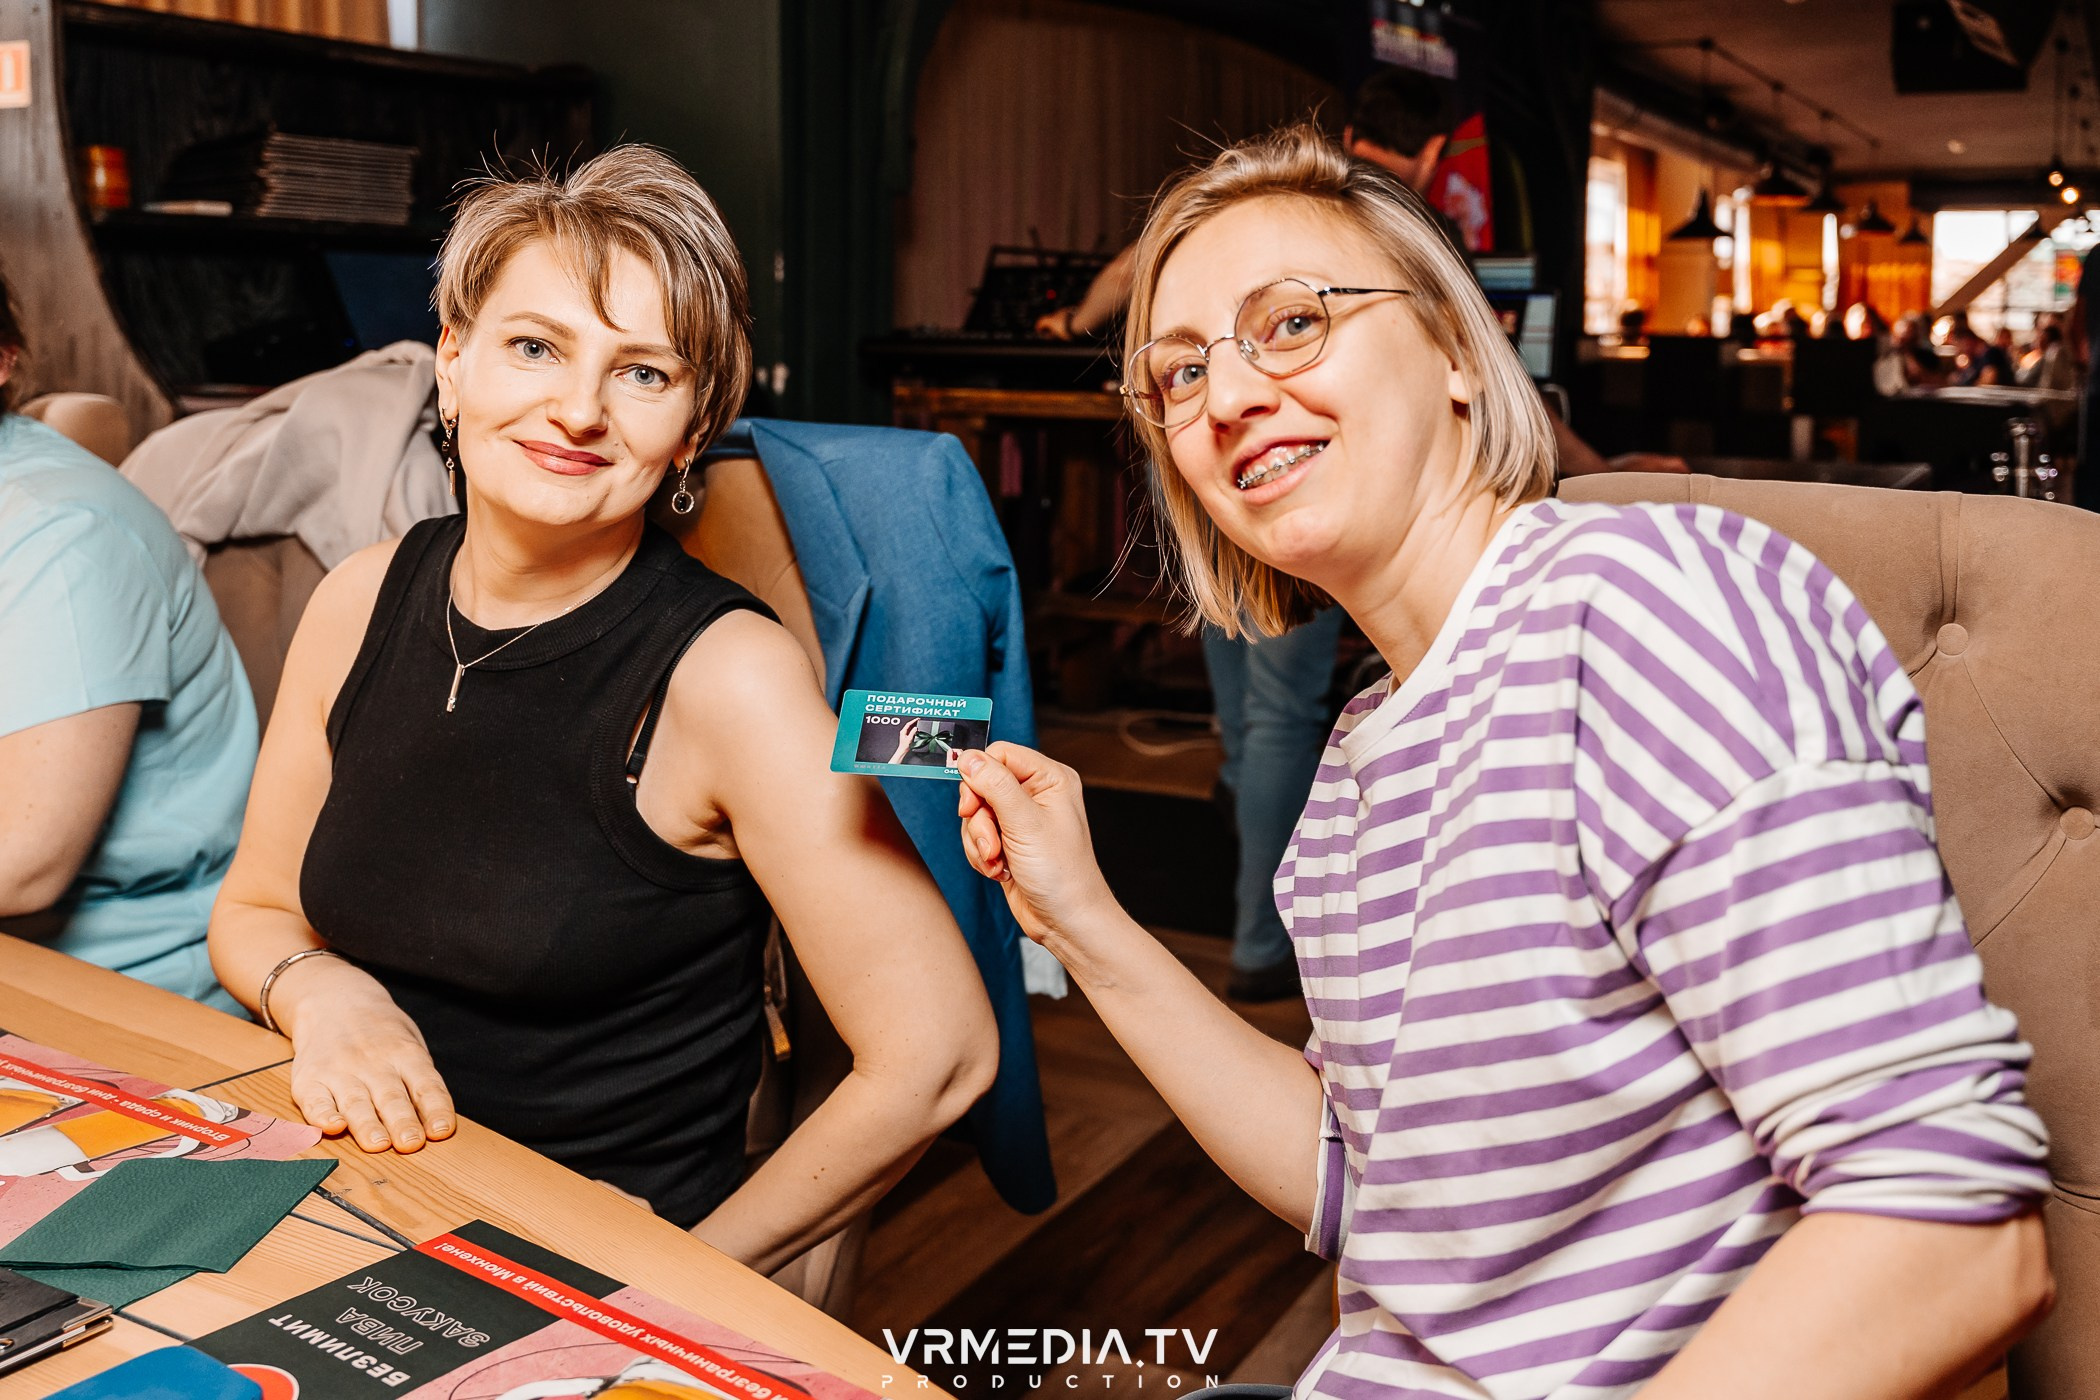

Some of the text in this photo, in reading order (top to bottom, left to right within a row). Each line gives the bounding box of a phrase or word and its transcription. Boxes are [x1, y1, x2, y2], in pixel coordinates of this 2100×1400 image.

[865, 704, 960, 717] СЕРТИФИКАТ
[867, 694, 967, 708] ПОДАРОЧНЫЙ
[866, 715, 901, 726] 1000
[119, 1099, 161, 1118] среда
[159, 1114, 169, 1122] и
[172, 1116, 231, 1142] Вторник
[347, 1276, 491, 1348] ЗАКУСОК
[434, 1242, 772, 1399] безграничных удовольствий в Мюнхене!
[335, 1306, 424, 1356] ПИВА
[268, 1314, 411, 1387] БЕЗЛИМИТ
